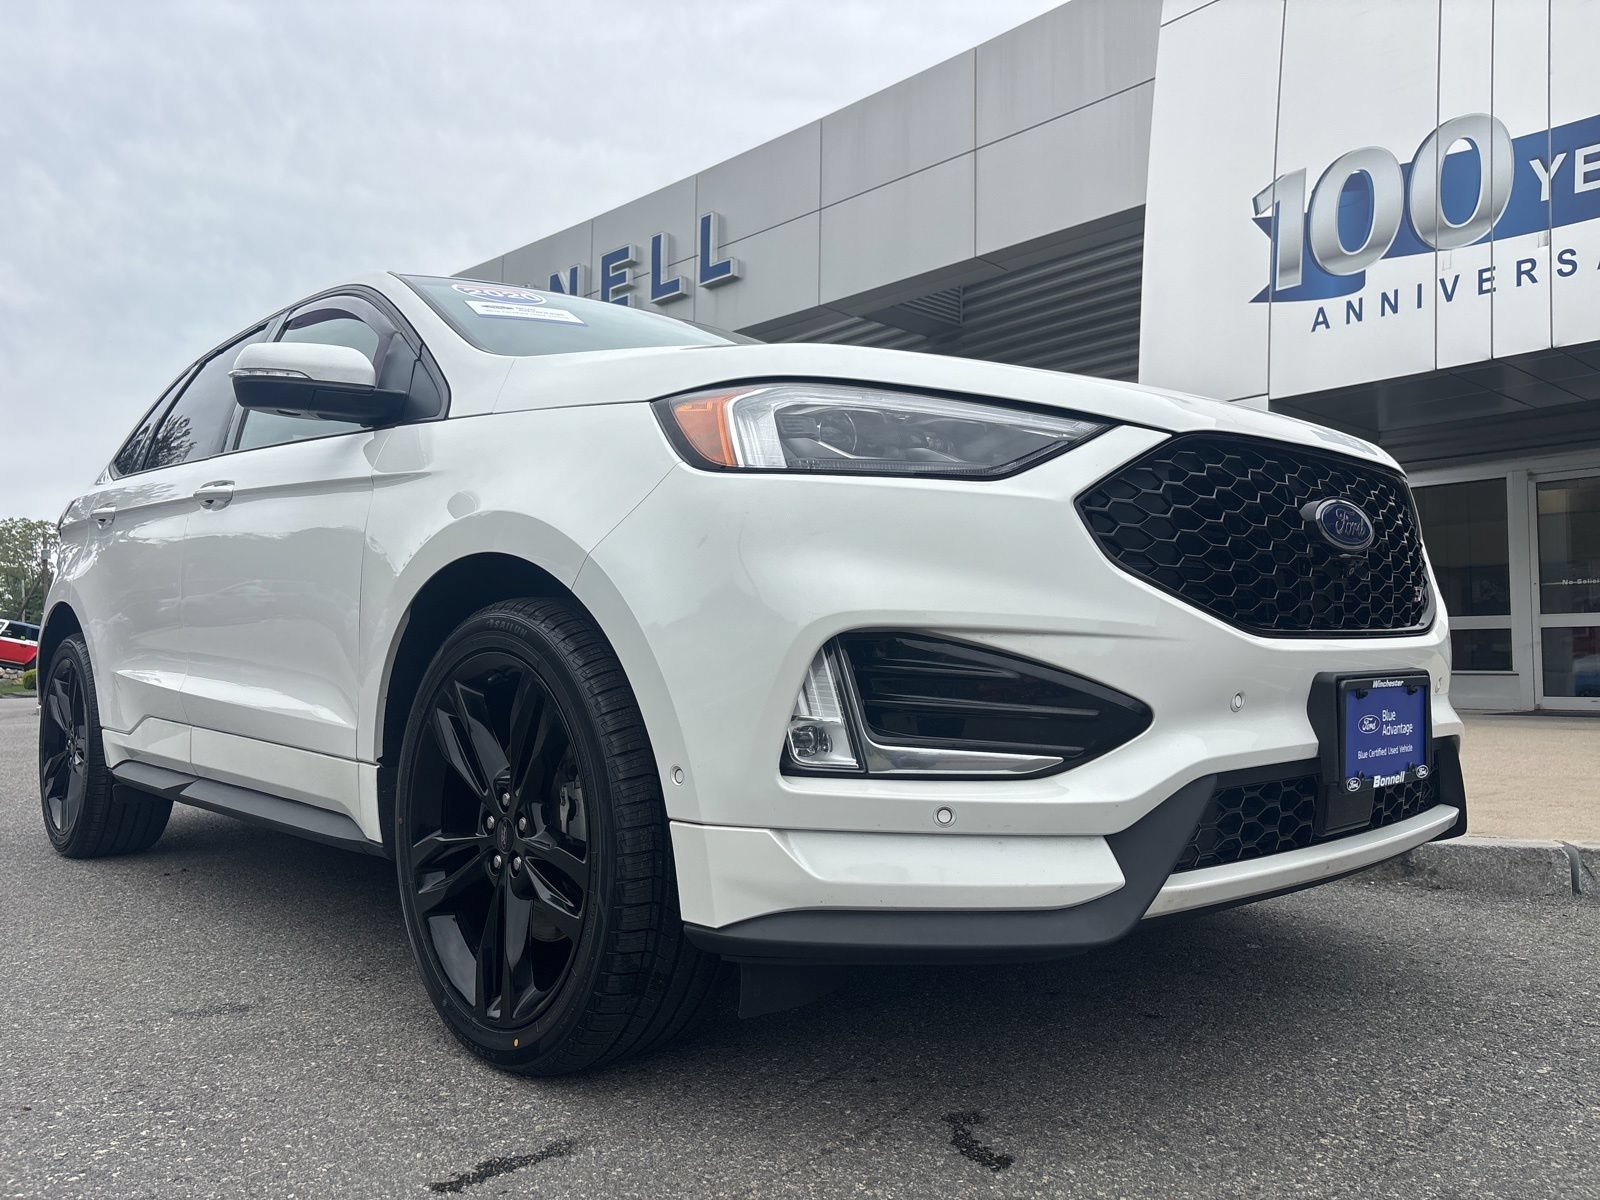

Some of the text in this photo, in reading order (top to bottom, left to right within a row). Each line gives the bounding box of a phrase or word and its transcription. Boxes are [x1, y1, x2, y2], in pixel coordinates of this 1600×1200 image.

[1252, 112, 1514, 291] 100
[464, 287, 536, 301] 2020
[1311, 247, 1600, 333] ANNIVERS
[1335, 508, 1366, 537] Ford
[1372, 679, 1404, 688] Winchester
[1382, 709, 1396, 721] Blue
[1382, 722, 1413, 736] Advantage
[1357, 744, 1413, 759] Blue Certified Used Vehicle
[1373, 771, 1406, 788] Bonnell
